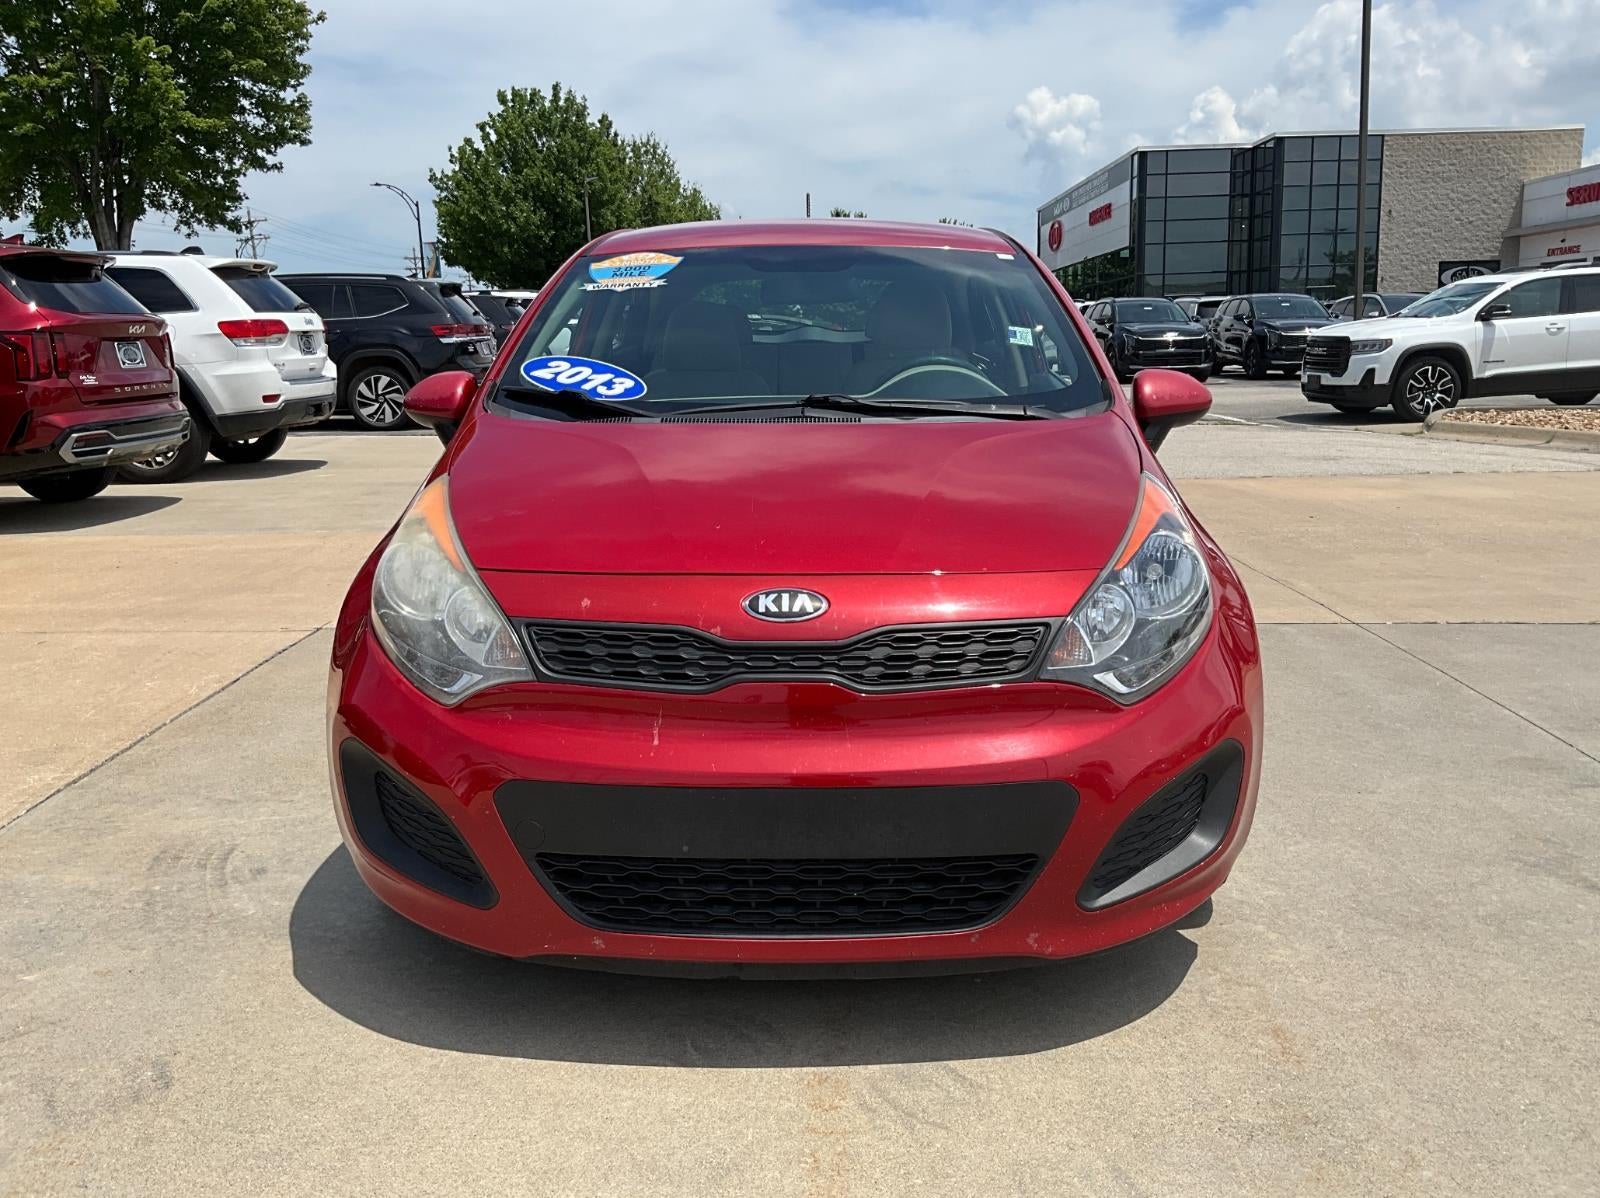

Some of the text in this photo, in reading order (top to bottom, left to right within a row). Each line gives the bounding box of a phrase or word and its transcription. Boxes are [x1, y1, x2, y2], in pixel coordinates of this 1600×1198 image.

[1547, 244, 1581, 257] ENTRANCE
[611, 270, 648, 278] MILE
[592, 282, 656, 290] WARRANTY
[529, 360, 636, 396] 2013
[758, 593, 814, 613] KIA
